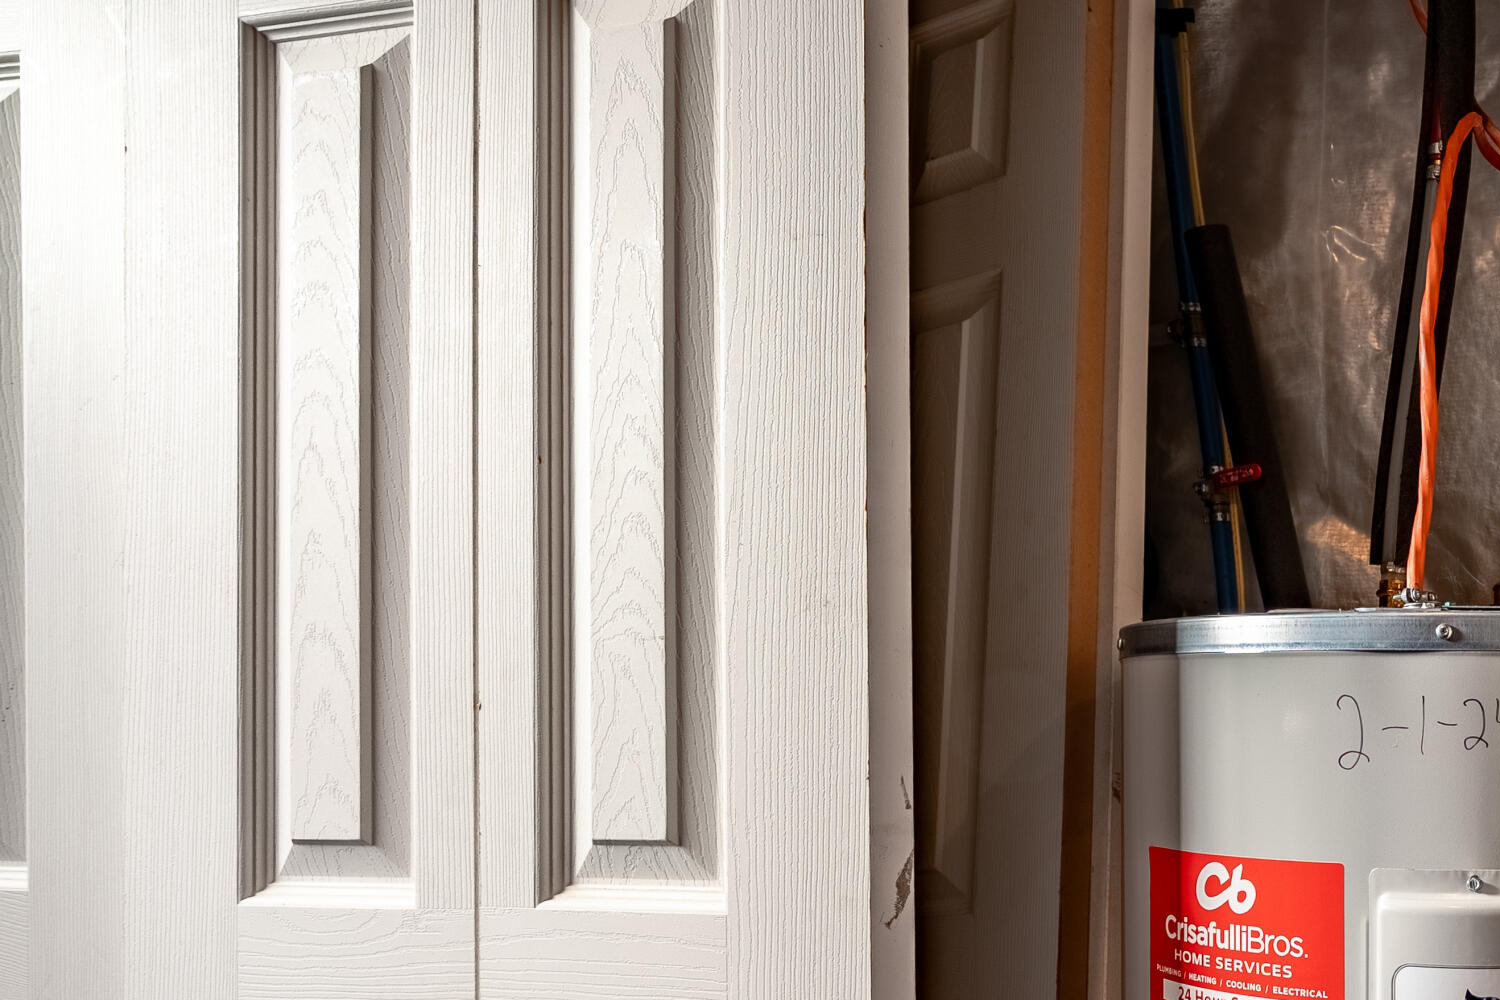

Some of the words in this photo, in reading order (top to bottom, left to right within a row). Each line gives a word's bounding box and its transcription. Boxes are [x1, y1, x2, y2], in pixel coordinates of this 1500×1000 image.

[1174, 948, 1211, 967] HOME
[1216, 956, 1293, 979] SERVICES
[1156, 963, 1182, 978] PLUMBING
[1188, 973, 1217, 985] HEATING
[1226, 979, 1262, 992] COOLING
[1272, 986, 1328, 999] ELECTRICAL
